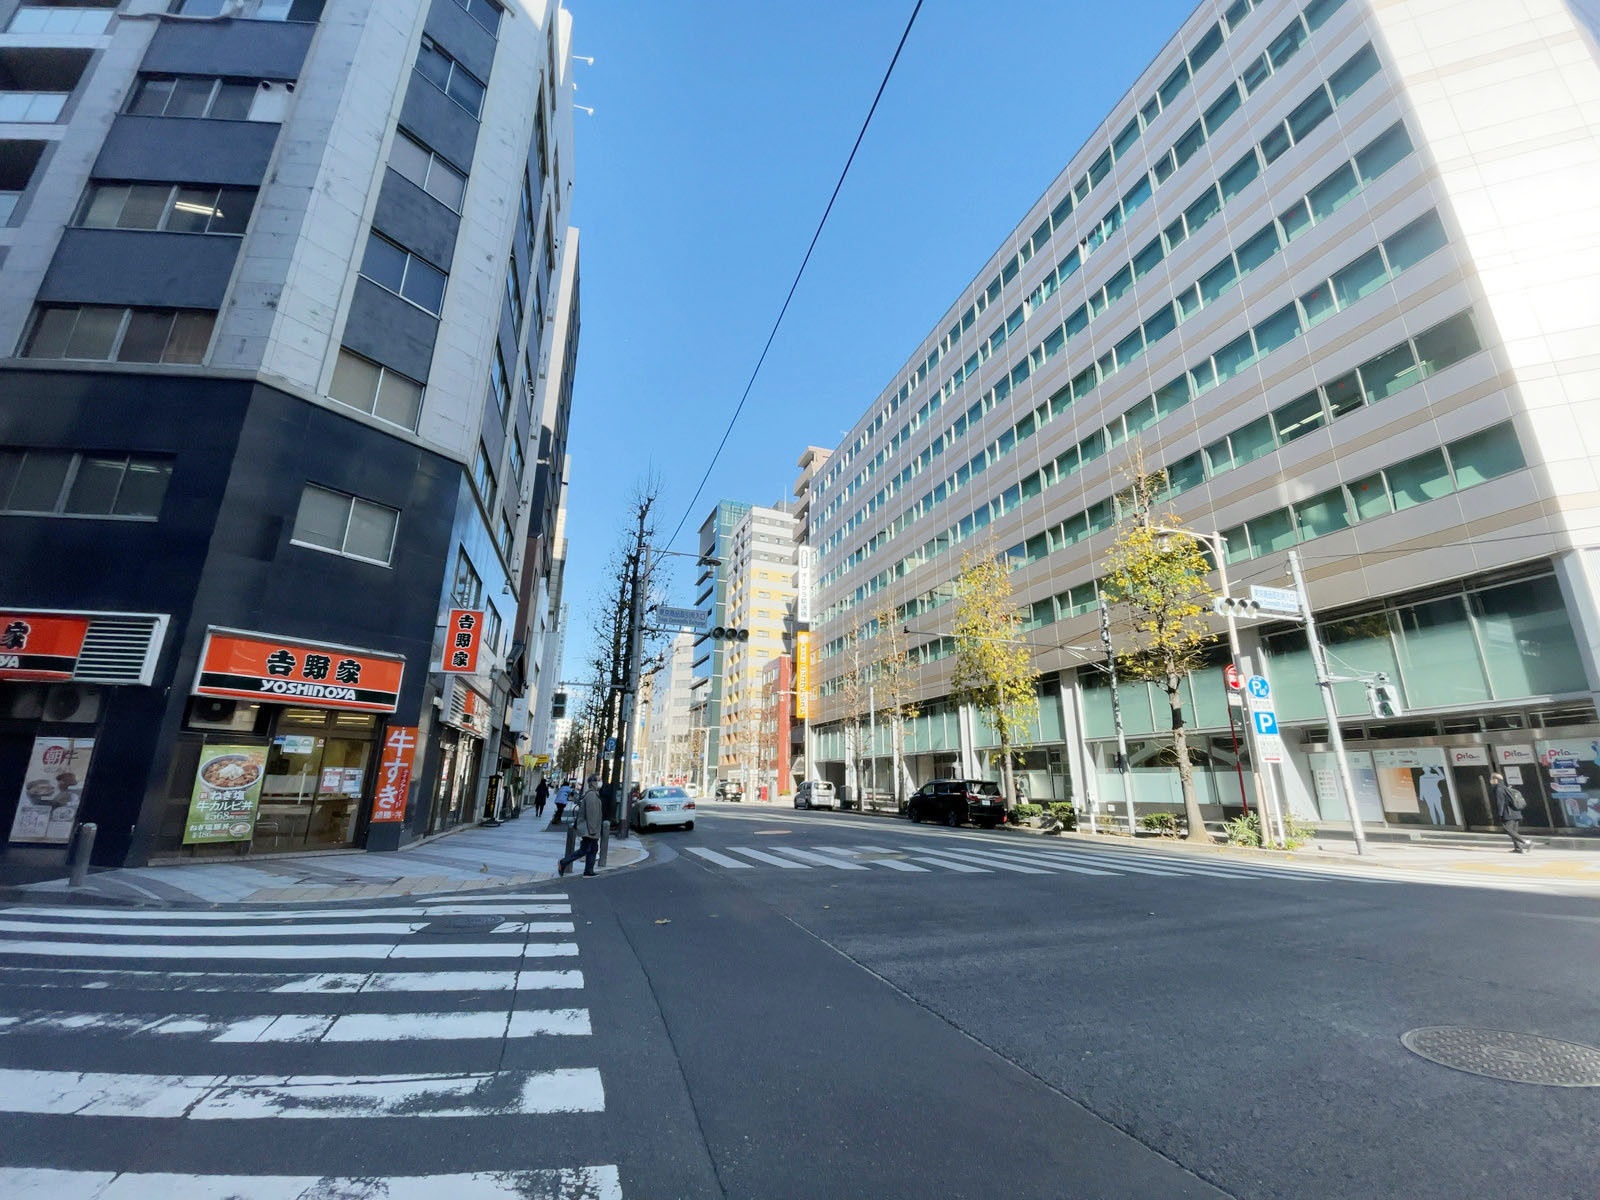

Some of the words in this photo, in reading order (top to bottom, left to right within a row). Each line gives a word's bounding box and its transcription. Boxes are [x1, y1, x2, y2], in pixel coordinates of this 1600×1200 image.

[452, 613, 475, 668] 吉野家
[265, 649, 362, 685] 吉野家
[259, 679, 357, 701] YOSHINOYA
[1259, 713, 1273, 732] P
[378, 729, 414, 808] 牛すき
[196, 801, 253, 812] 牛カルビ丼
